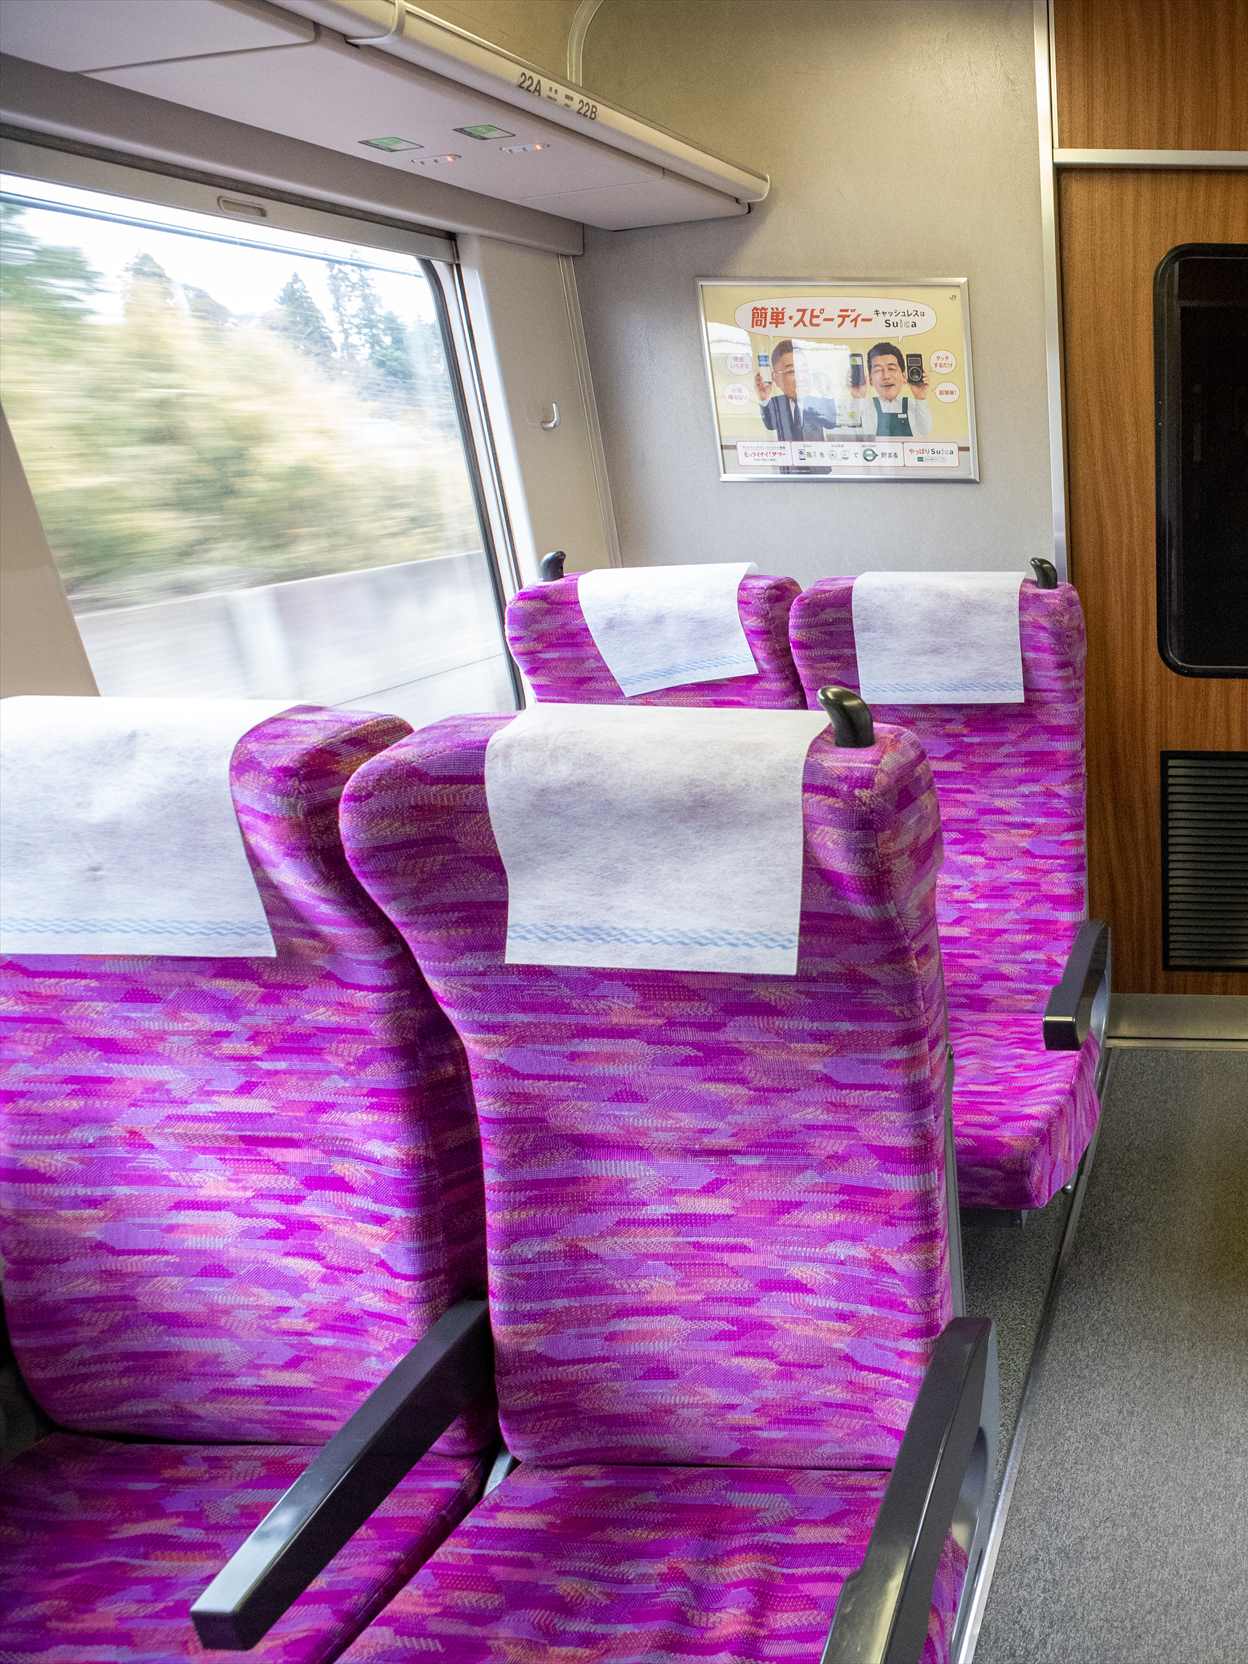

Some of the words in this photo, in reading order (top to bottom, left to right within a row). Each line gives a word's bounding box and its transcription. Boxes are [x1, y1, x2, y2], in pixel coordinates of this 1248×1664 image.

[517, 72, 542, 97] 22A
[576, 99, 599, 121] 22B
[751, 306, 873, 329] 簡単・スピーディー
[873, 308, 926, 318] キャッシュレスは
[884, 318, 917, 328] Suica
